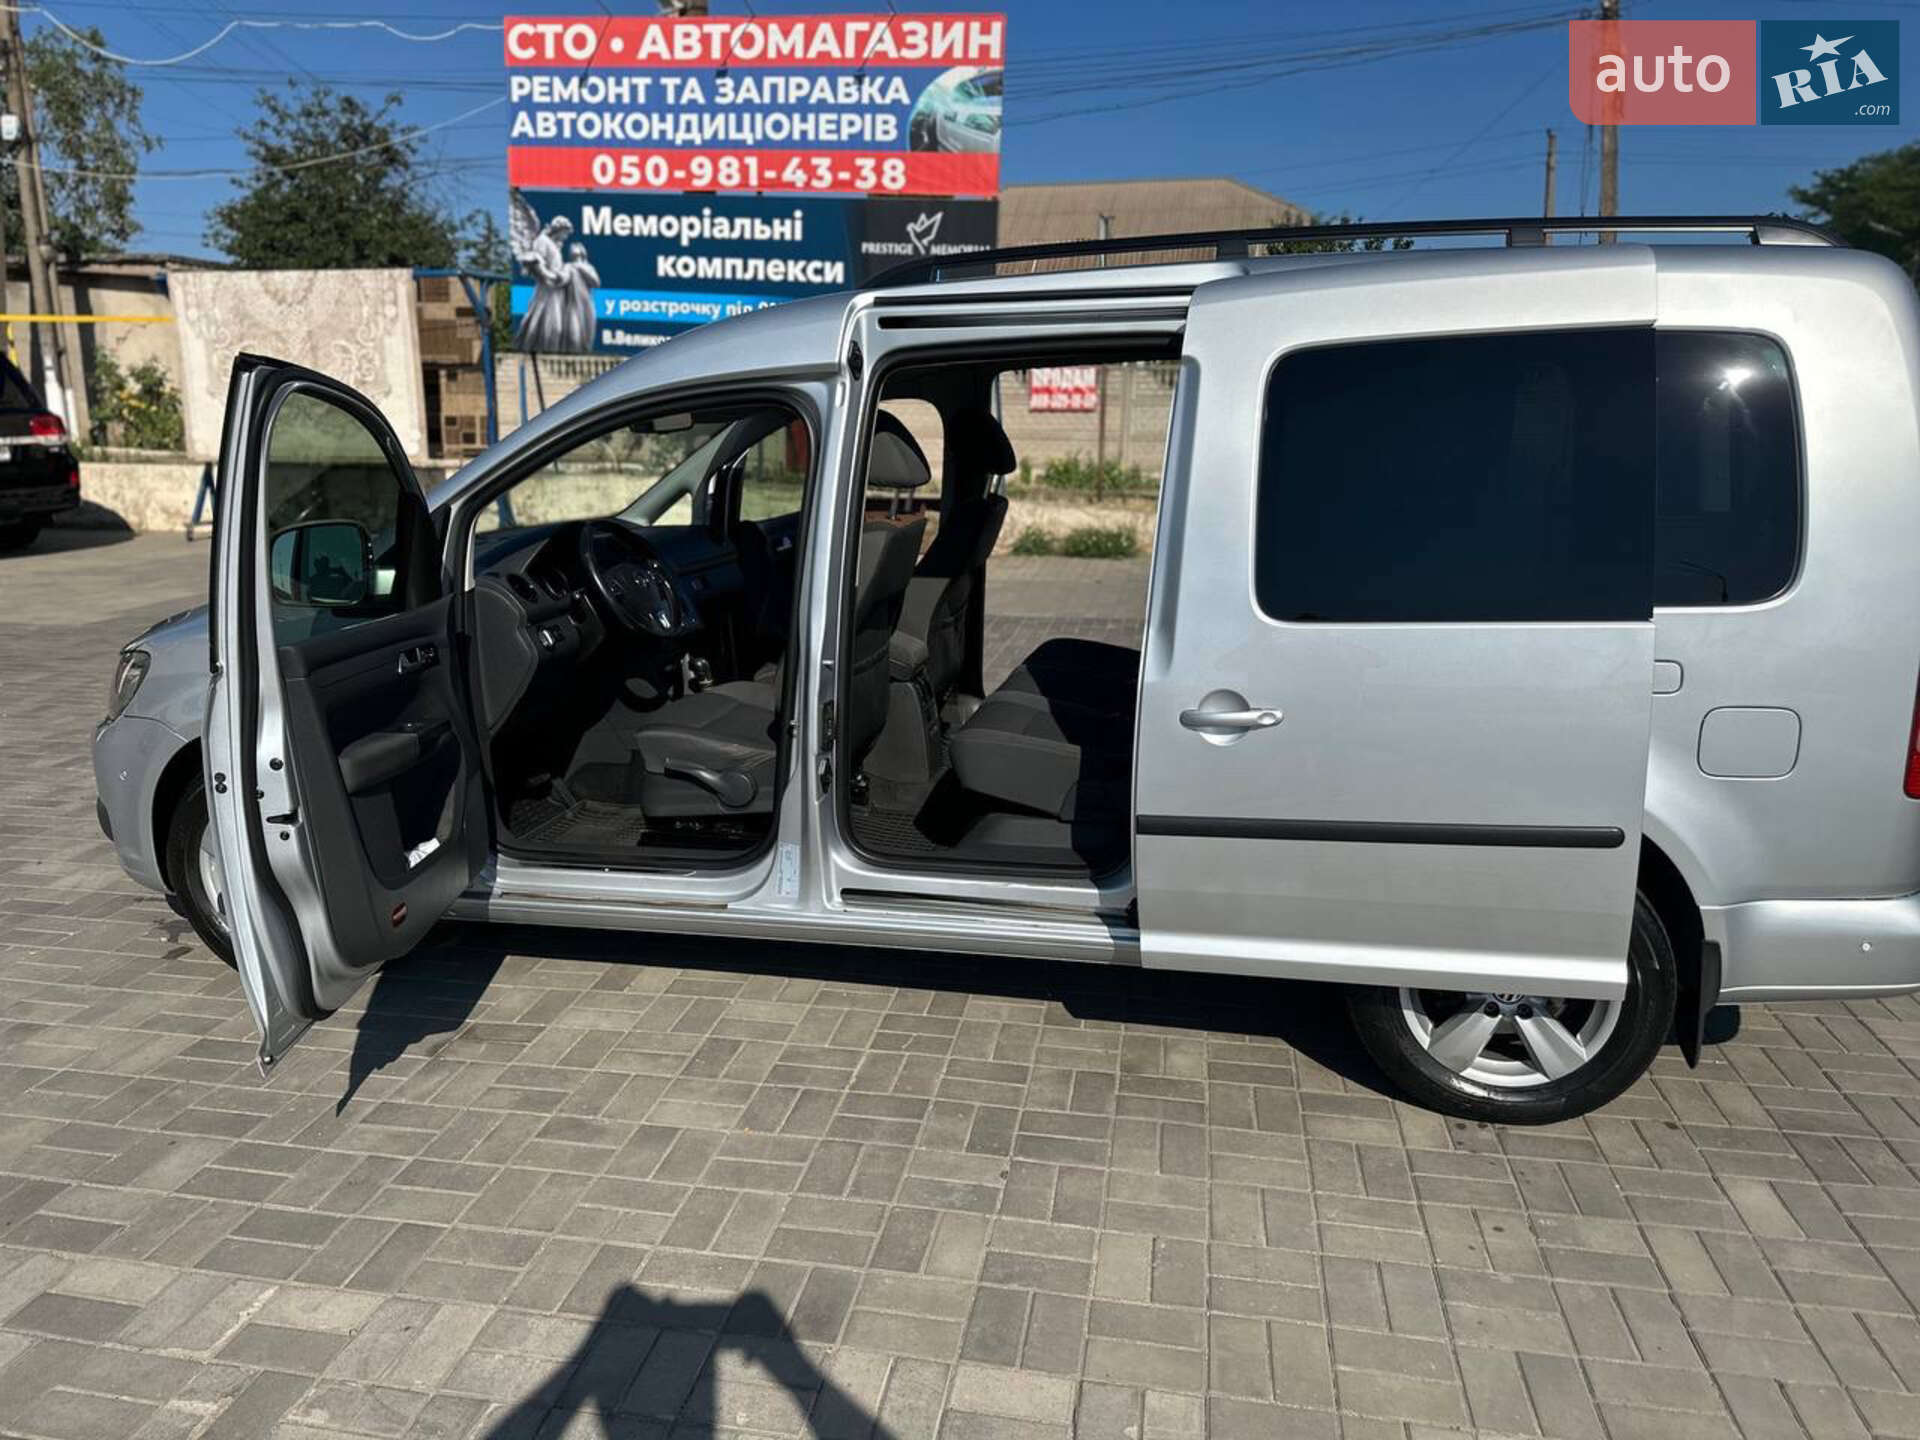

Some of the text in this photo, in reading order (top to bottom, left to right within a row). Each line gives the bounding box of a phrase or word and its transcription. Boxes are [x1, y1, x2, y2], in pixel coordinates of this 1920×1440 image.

[507, 20, 1001, 60] СТО АВТОМАГАЗИН
[510, 74, 911, 105] РЕМОНТ ТА ЗАПРАВКА
[510, 112, 899, 146] АВТОКОНДИЦІОНЕРІВ
[591, 154, 907, 189] 050-981-43-38
[581, 205, 803, 247] Меморіальні
[861, 241, 915, 256] PRESTIGE
[656, 253, 845, 284] комплекси
[604, 299, 616, 315] у
[620, 299, 722, 321] розстрочку
